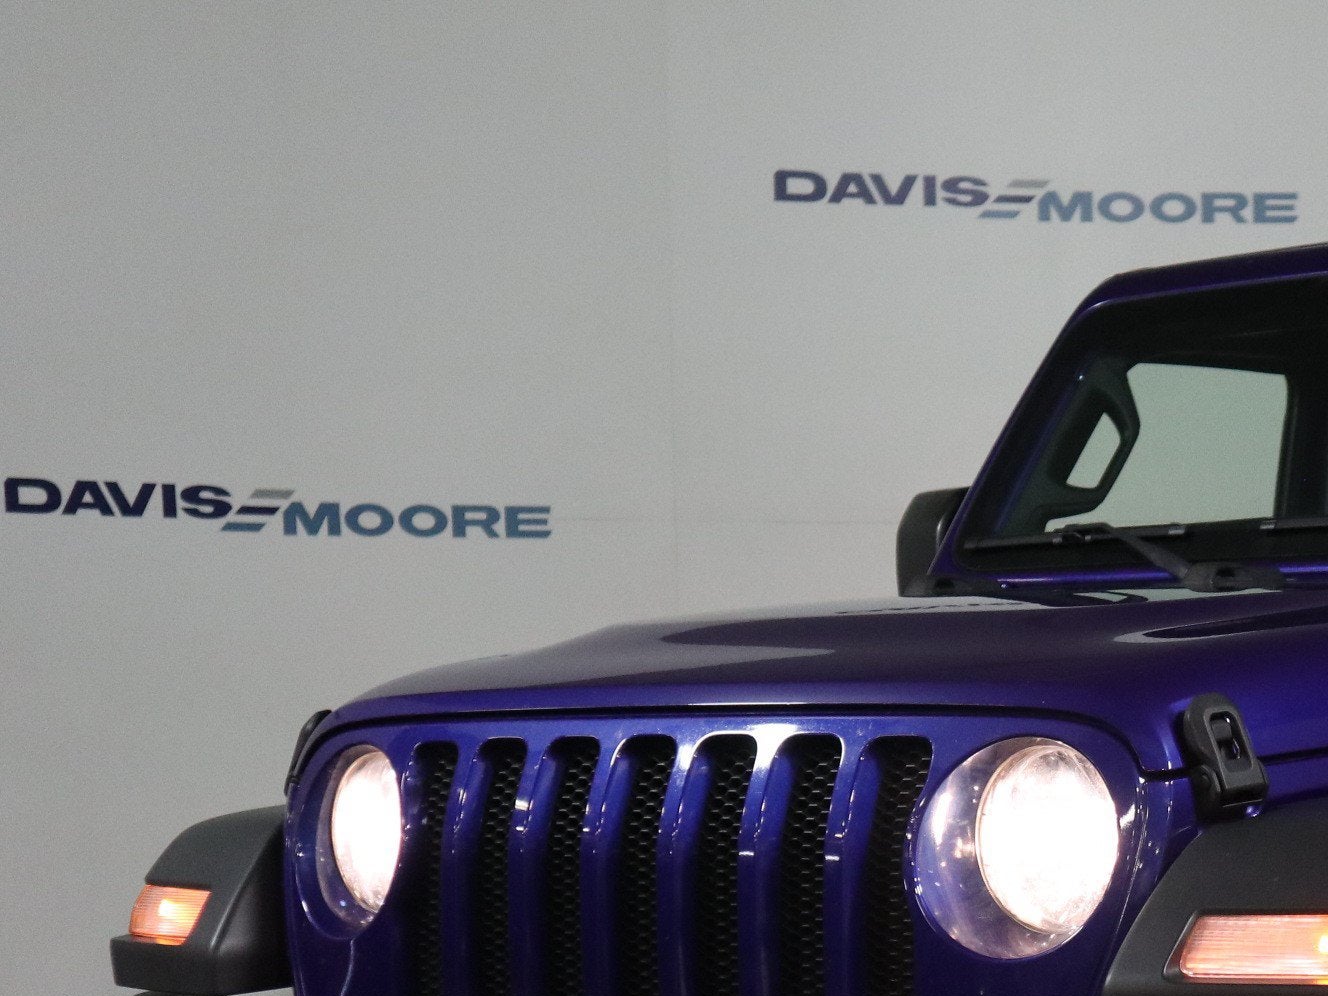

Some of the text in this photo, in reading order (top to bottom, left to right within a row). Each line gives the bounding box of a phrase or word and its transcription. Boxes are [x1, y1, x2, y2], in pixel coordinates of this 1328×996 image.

[772, 168, 1299, 224] DAVIS MOORE
[3, 476, 552, 539] DAVIS MOORE
